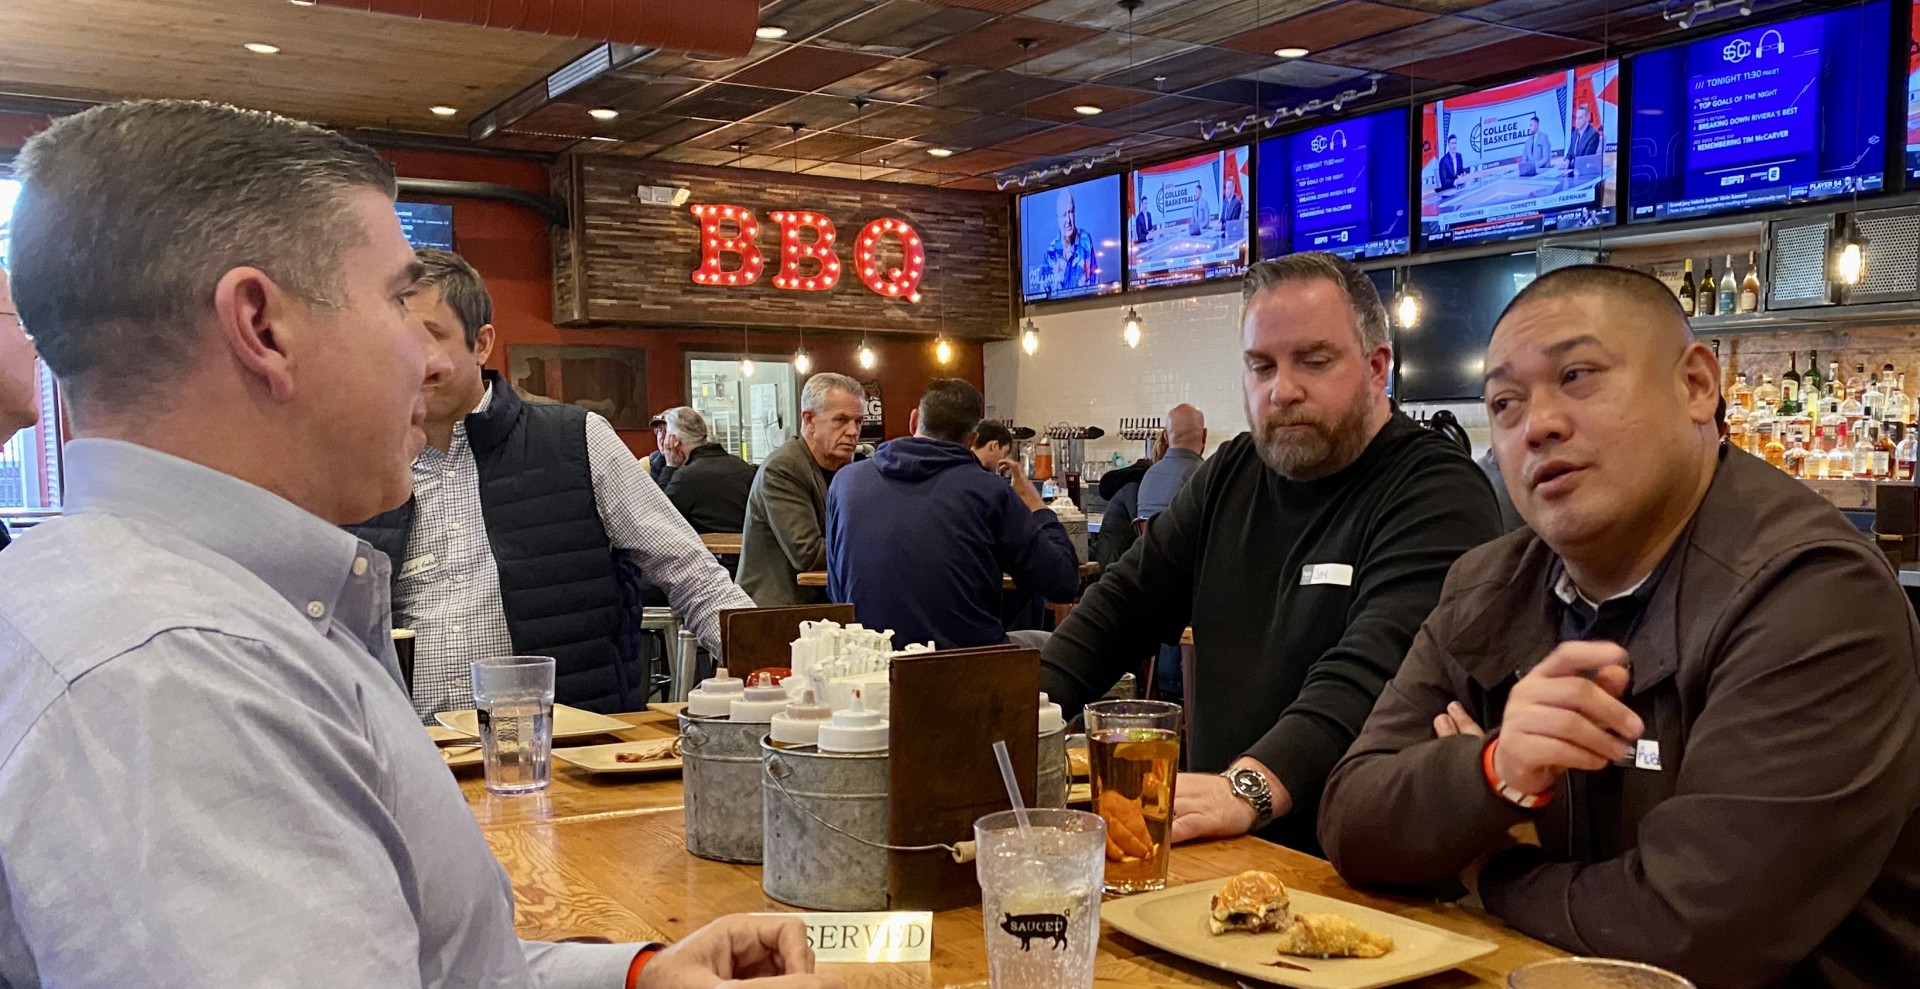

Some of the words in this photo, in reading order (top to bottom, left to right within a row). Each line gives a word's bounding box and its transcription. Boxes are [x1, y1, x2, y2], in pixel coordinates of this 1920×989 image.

[1707, 73, 1742, 88] TONIGHT
[1743, 69, 1762, 81] 11:30
[1699, 101, 1711, 110] TOP
[1712, 97, 1733, 108] GOALS
[1734, 95, 1743, 103] OF
[1744, 93, 1757, 101] THE
[1757, 88, 1778, 99] NIGHT
[1698, 119, 1729, 131] BREAKING
[1729, 115, 1751, 126] DOWN
[1751, 109, 1781, 121] RIVIERA'S
[1782, 106, 1798, 116] BEST
[1484, 122, 1518, 136] COLLEGE
[1484, 128, 1533, 146] BASKETBALL
[1697, 138, 1742, 152] REMEMBERING
[1742, 135, 1755, 144] TIM
[1755, 129, 1789, 142] McCARVER
[1720, 174, 1745, 186] ESPN
[1809, 180, 1833, 191] PLAYER
[1165, 188, 1188, 200] COLLEGE
[1165, 194, 1198, 208] BASKETBALL
[1511, 200, 1537, 210] CORNETTE
[1559, 192, 1587, 202] FARNHAM
[1636, 205, 1654, 215] ESPN
[690, 204, 925, 303] BBQ
[1010, 920, 1064, 932] SAUCED
